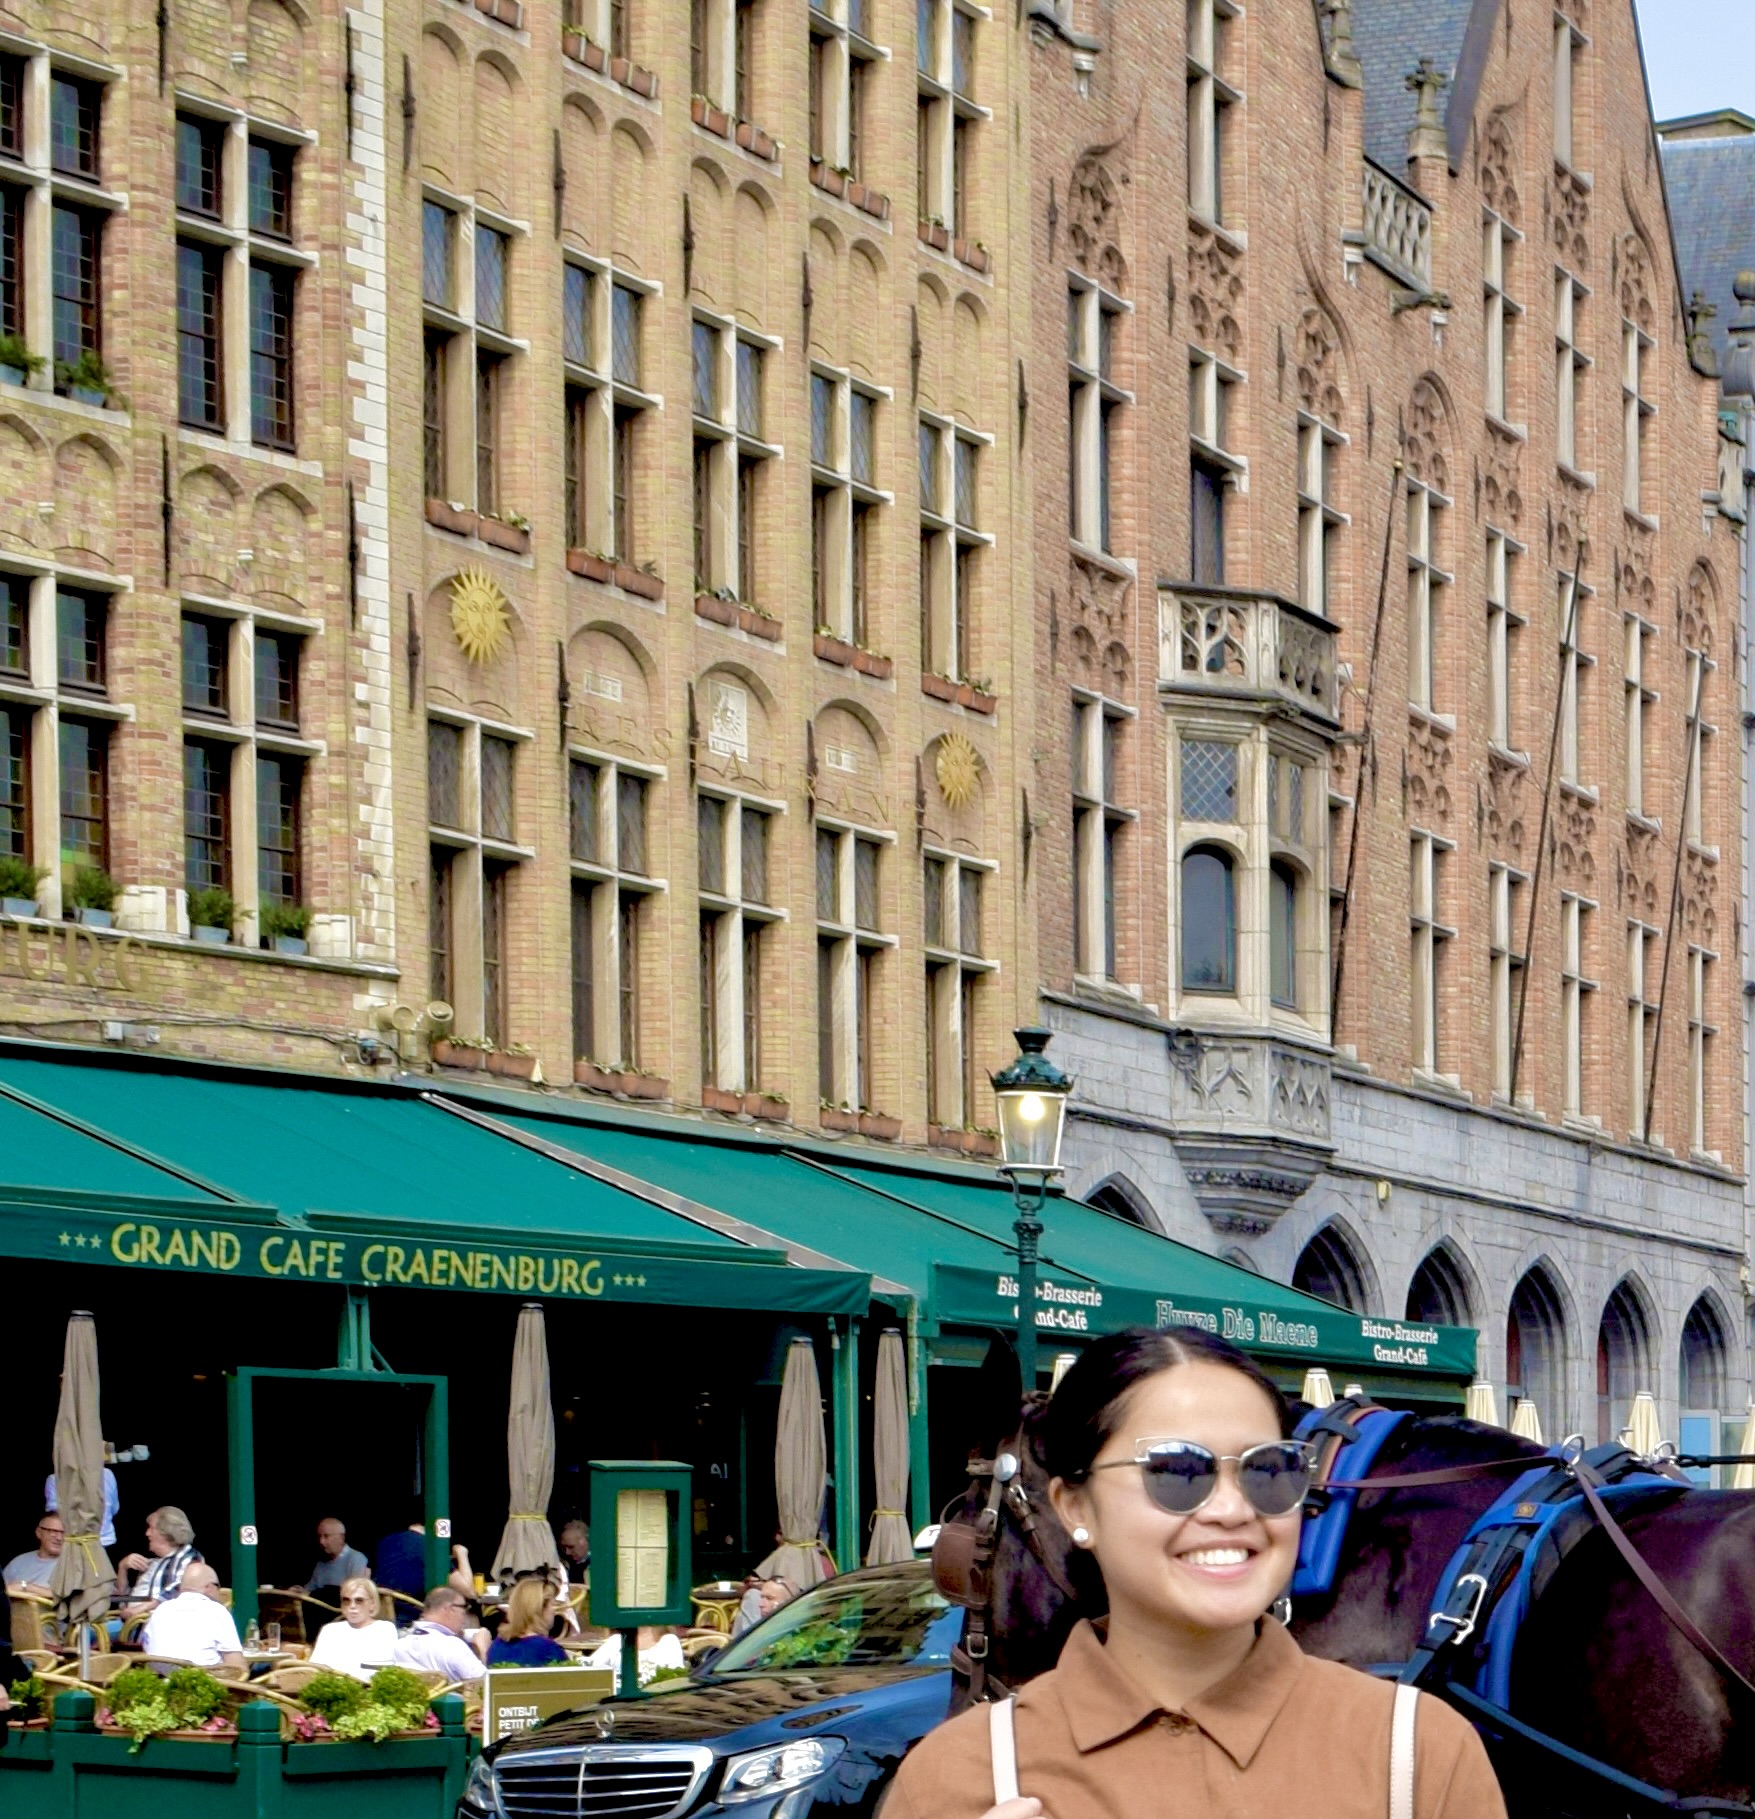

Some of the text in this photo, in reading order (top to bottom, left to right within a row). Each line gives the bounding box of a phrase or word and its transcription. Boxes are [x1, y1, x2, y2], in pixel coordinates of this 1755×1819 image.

[110, 1222, 605, 1297] GRAND CAFE CRAENENBURG
[1221, 1306, 1256, 1340] Die
[1258, 1312, 1319, 1348] Maene
[1360, 1319, 1439, 1346] Bistro-Brasserie
[1372, 1343, 1429, 1367] Grand-Café
